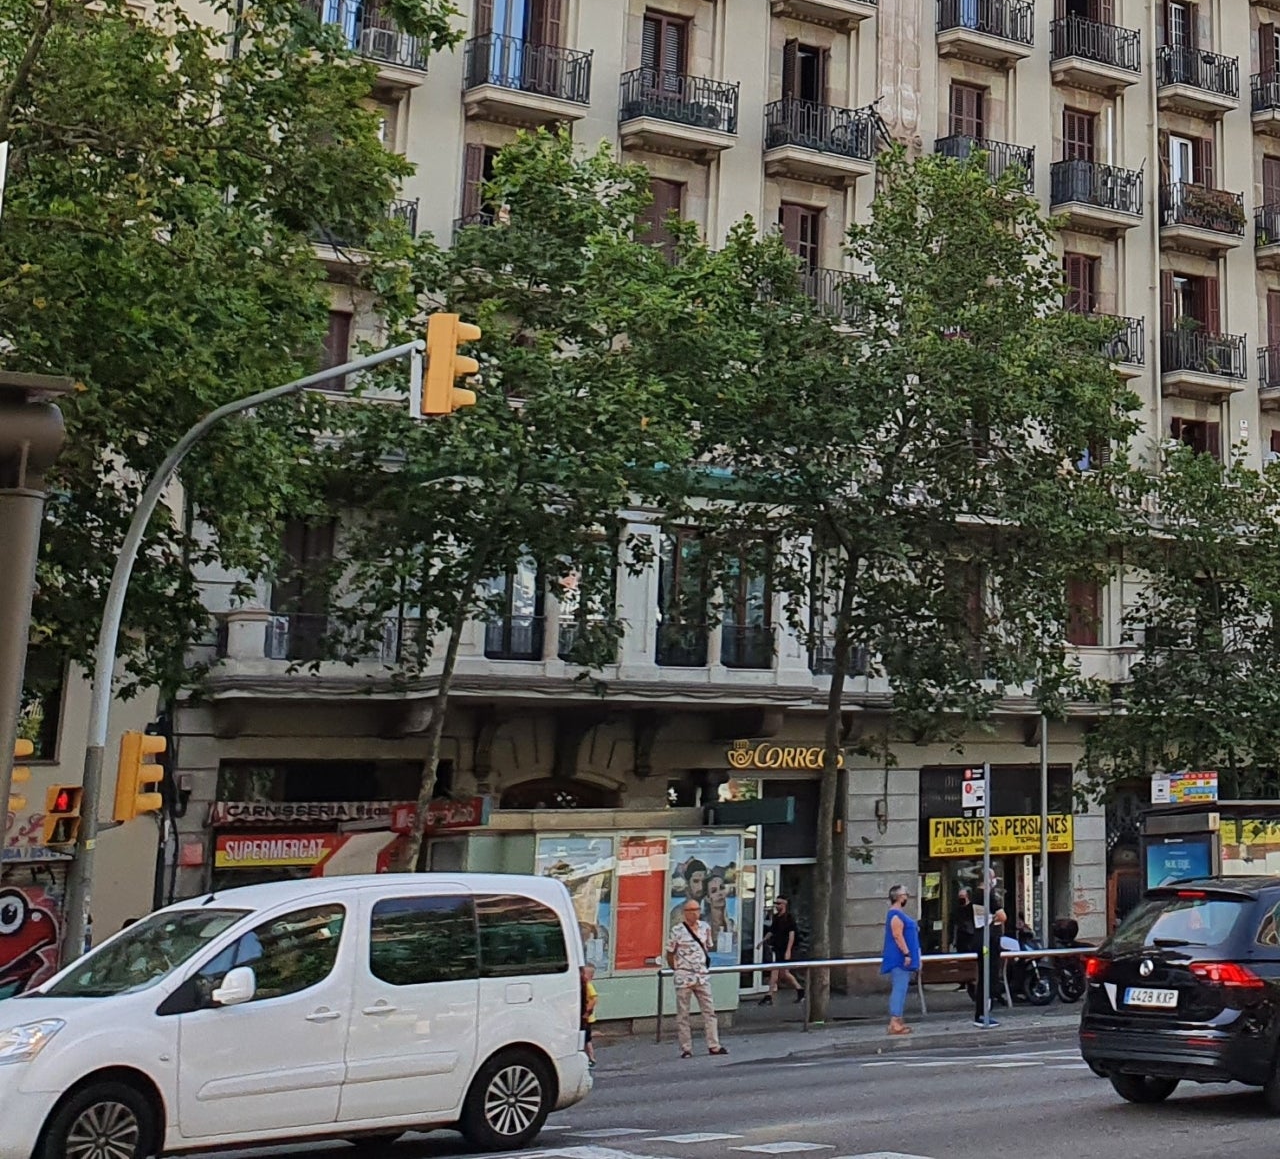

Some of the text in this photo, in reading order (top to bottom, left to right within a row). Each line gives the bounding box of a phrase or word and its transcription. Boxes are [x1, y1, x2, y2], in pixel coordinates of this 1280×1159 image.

[754, 742, 845, 770] CORRES
[226, 804, 348, 818] CARNISSERIA
[934, 819, 999, 838] FINESTRS
[225, 838, 325, 861] SUPERMERCAT
[1131, 990, 1154, 1003] 4428
